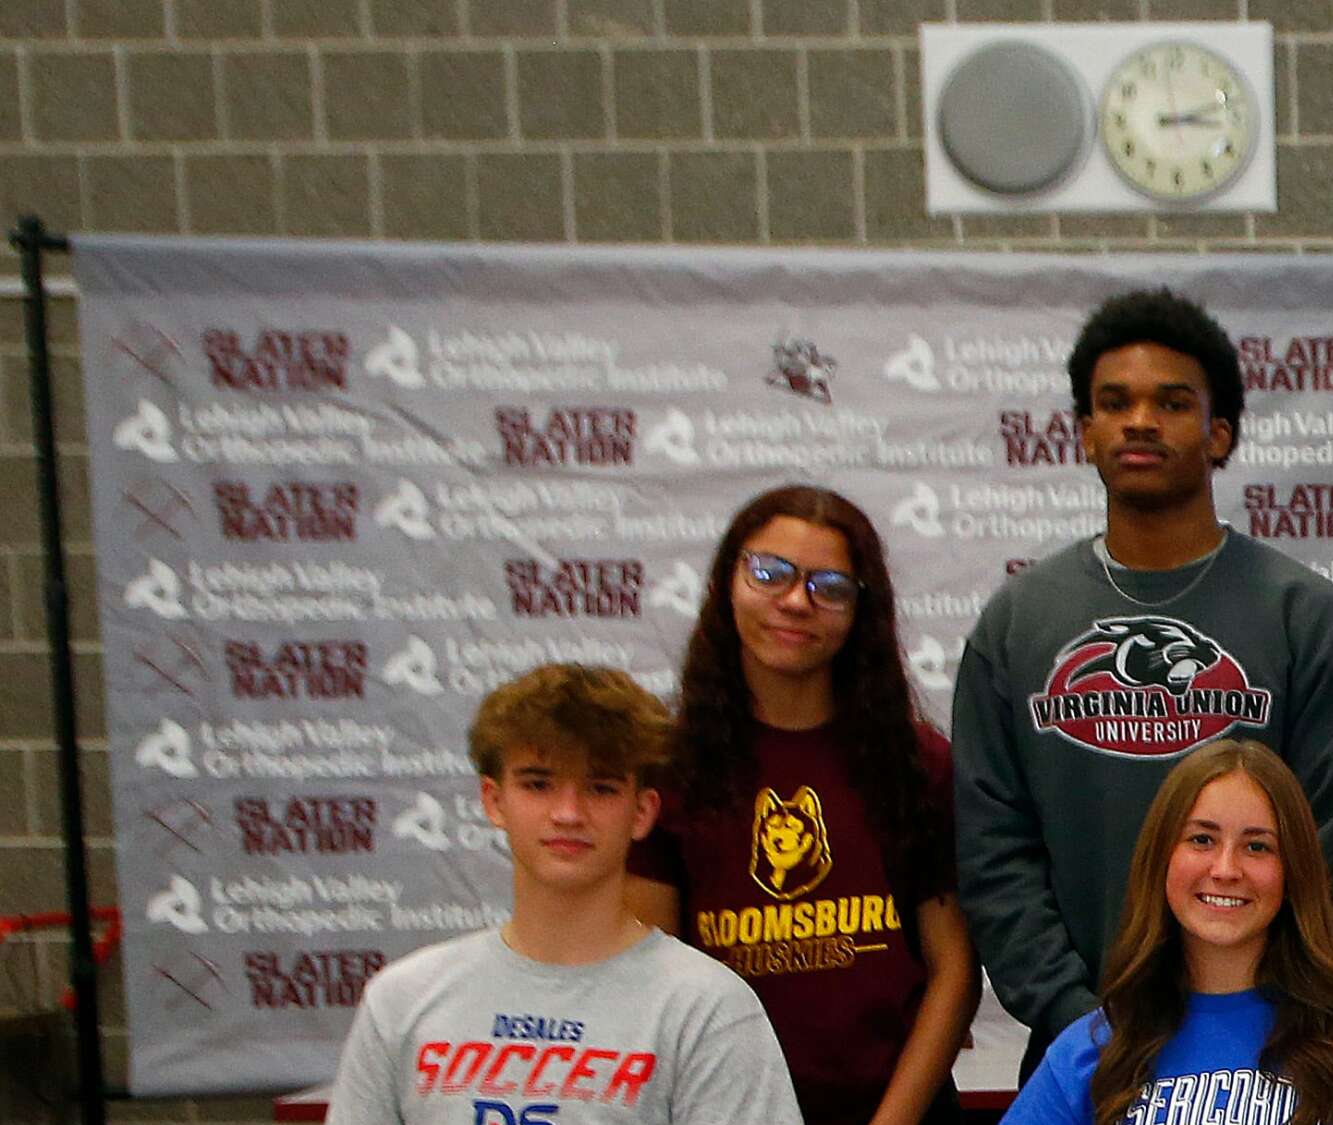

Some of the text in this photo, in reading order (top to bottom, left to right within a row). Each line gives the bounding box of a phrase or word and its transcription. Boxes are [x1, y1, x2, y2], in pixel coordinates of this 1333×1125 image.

[204, 330, 350, 362] SLATER
[210, 359, 347, 390] NATION
[497, 407, 637, 437] SLATER
[503, 436, 634, 466] NATION
[215, 482, 359, 512] SLATER
[220, 511, 357, 542] NATION
[505, 560, 644, 589] SLATER
[512, 587, 641, 618] NATION
[225, 640, 368, 669] SLATER
[231, 668, 366, 700] NATION
[1037, 691, 1267, 724] VIRGINIA UNION
[1095, 719, 1201, 744] UNIVERSITY
[234, 797, 376, 825] SLATER
[242, 825, 374, 855] NATION
[493, 1013, 585, 1043] DESALES
[416, 1041, 656, 1108] SOCCER
